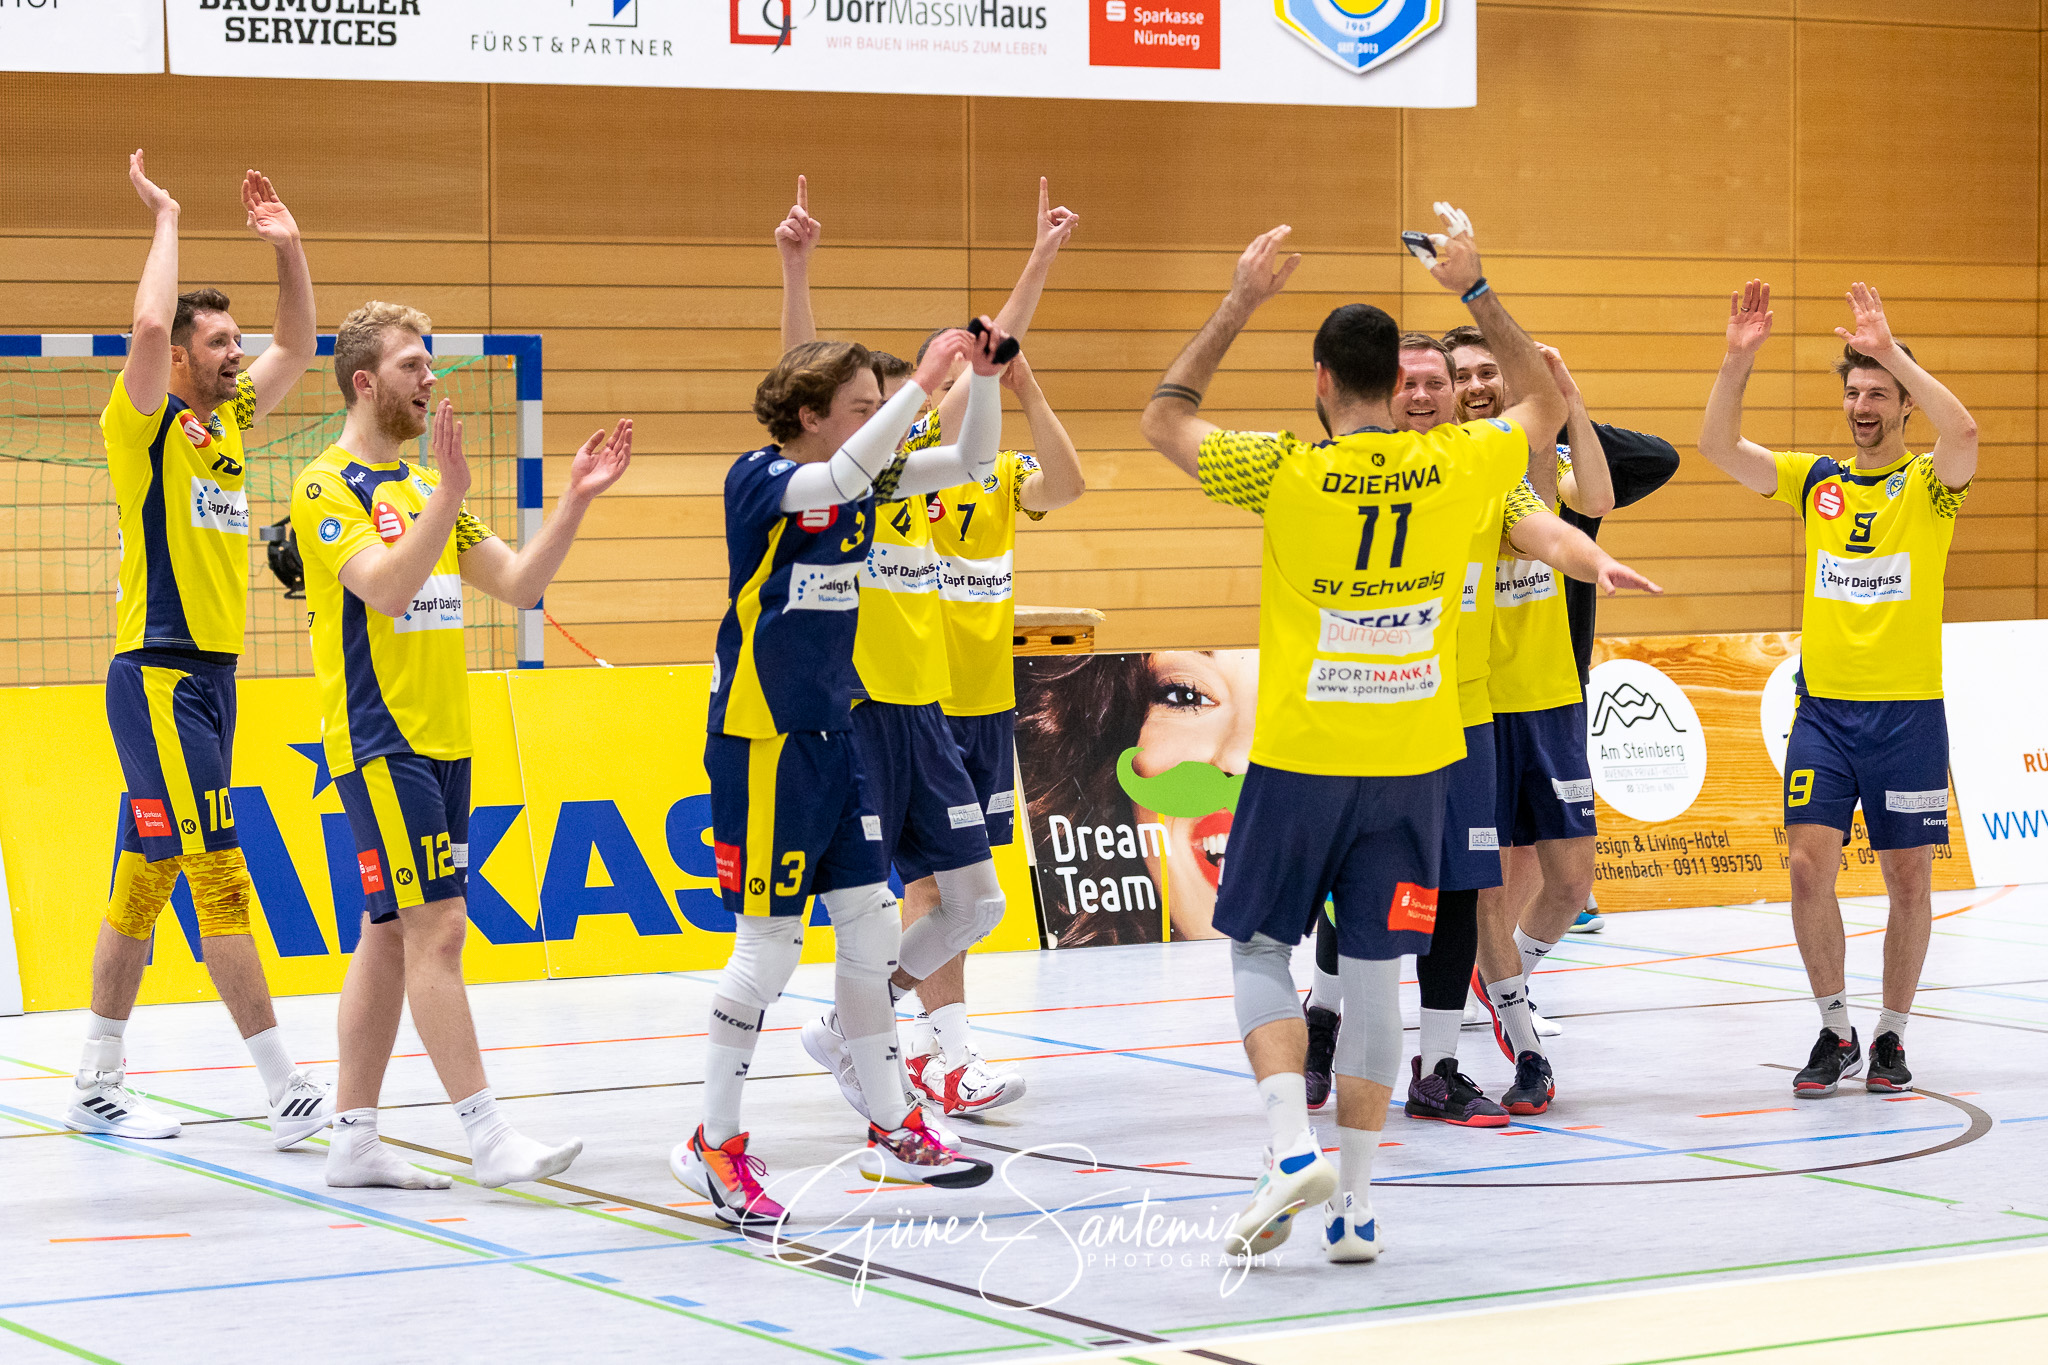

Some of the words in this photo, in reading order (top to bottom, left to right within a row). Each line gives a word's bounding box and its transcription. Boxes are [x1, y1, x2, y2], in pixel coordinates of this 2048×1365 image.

[1133, 7, 1204, 26] Sparkasse
[1345, 21, 1371, 31] 1967
[225, 17, 397, 46] SERVICES
[1133, 29, 1200, 50] Nürnberg
[471, 31, 543, 52] FÜRST
[571, 37, 673, 56] PARTNER
[826, 36, 852, 49] WIR
[857, 37, 902, 51] BAUEN
[906, 39, 928, 51] IHR
[933, 40, 969, 53] HAUS
[973, 41, 1001, 54] ZUM
[1005, 42, 1047, 56] LEBEN
[1357, 42, 1379, 54] 2013
[1322, 464, 1441, 494] DZIERWA
[1355, 502, 1412, 570] 11
[877, 563, 899, 577] apf
[943, 574, 965, 588] Zapf
[967, 573, 1012, 588] Daigfuss
[1312, 579, 1343, 595] SV
[1350, 571, 1446, 597] Schwaig
[1495, 581, 1511, 593] apf
[1852, 574, 1902, 590] Daigfuss
[413, 598, 437, 613] Zapf
[1327, 623, 1412, 647] pumpen
[1318, 664, 1432, 682] SPORTNANKA
[1601, 744, 1620, 760] Am
[1623, 741, 1685, 761] Steinberg
[1788, 769, 1815, 807] 9
[204, 787, 235, 832] 10
[1889, 794, 1947, 807] HÜTTINGE
[1923, 817, 1947, 827] Kemp
[1049, 815, 1171, 862] Dream
[1595, 837, 1630, 859] esign
[1634, 834, 1645, 852] &
[1652, 830, 1730, 855] Living-Hotel
[421, 832, 455, 880] 12
[775, 851, 806, 897] 3
[1594, 860, 1663, 880] öthenbach
[1674, 856, 1708, 876] 0911
[1711, 854, 1763, 874] 995750
[1055, 866, 1156, 914] Team
[1410, 897, 1437, 912] Spark
[1407, 909, 1437, 923] Nürnbe
